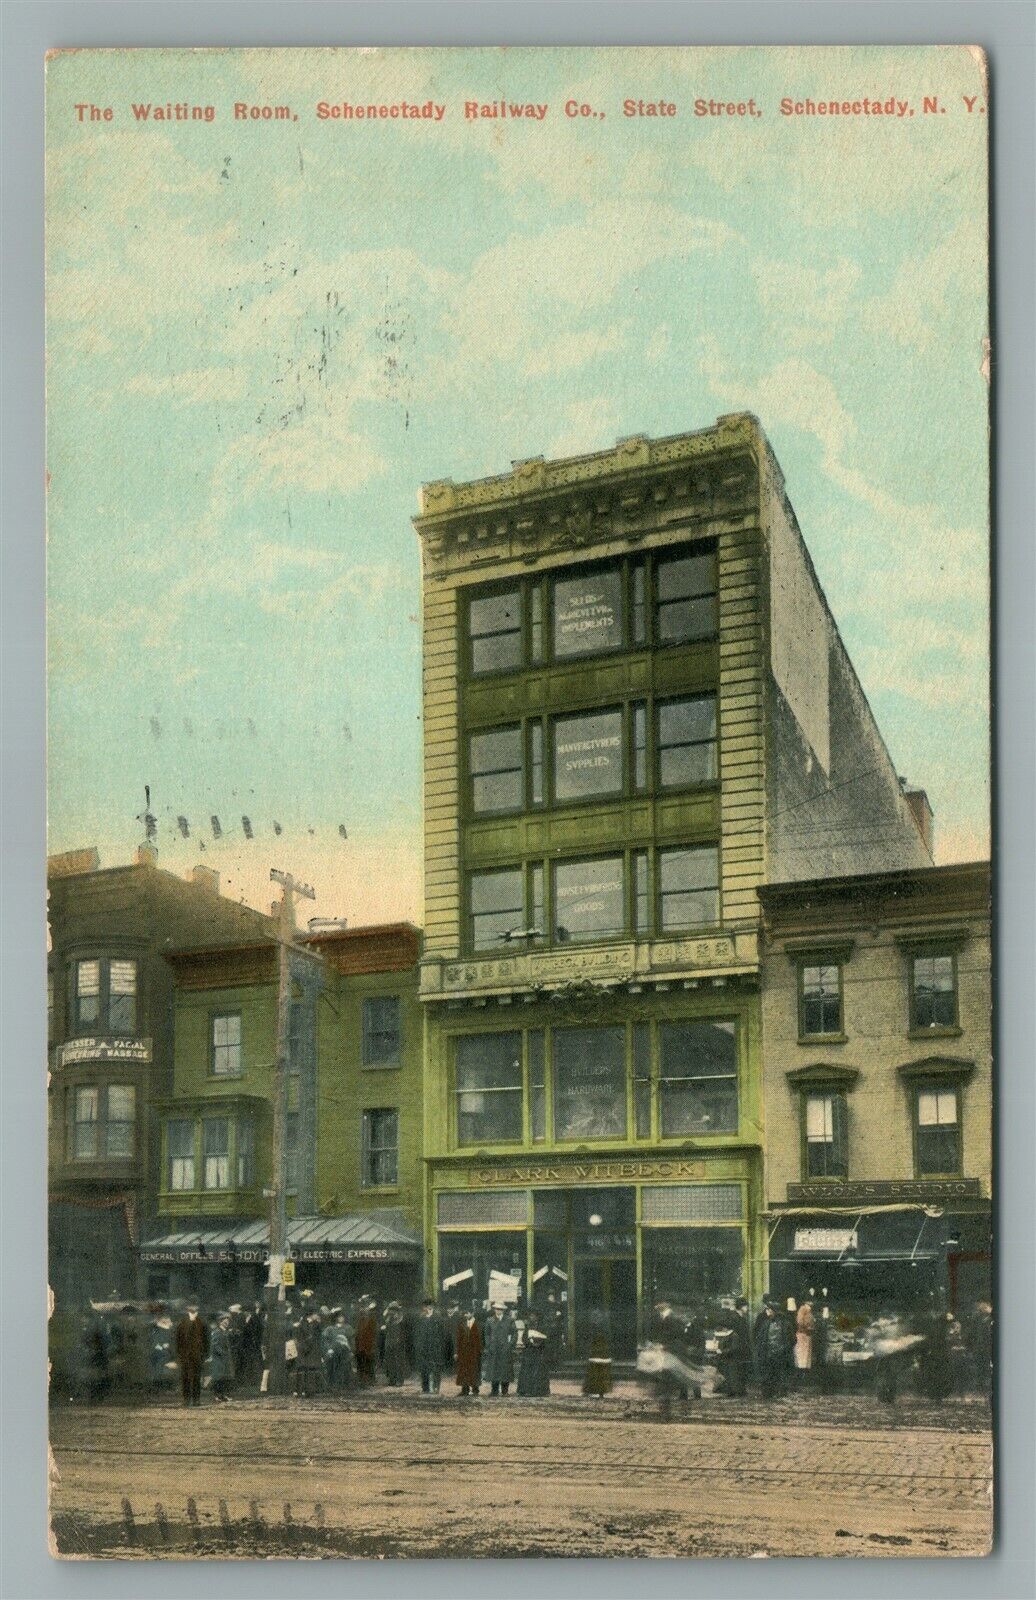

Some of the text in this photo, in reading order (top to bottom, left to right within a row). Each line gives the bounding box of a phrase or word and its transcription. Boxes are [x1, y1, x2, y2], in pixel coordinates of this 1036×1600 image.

[476, 1161, 697, 1183] CLARK WITBECK
[891, 1181, 967, 1194] STUDIO
[303, 1250, 343, 1259] ELECTRIC
